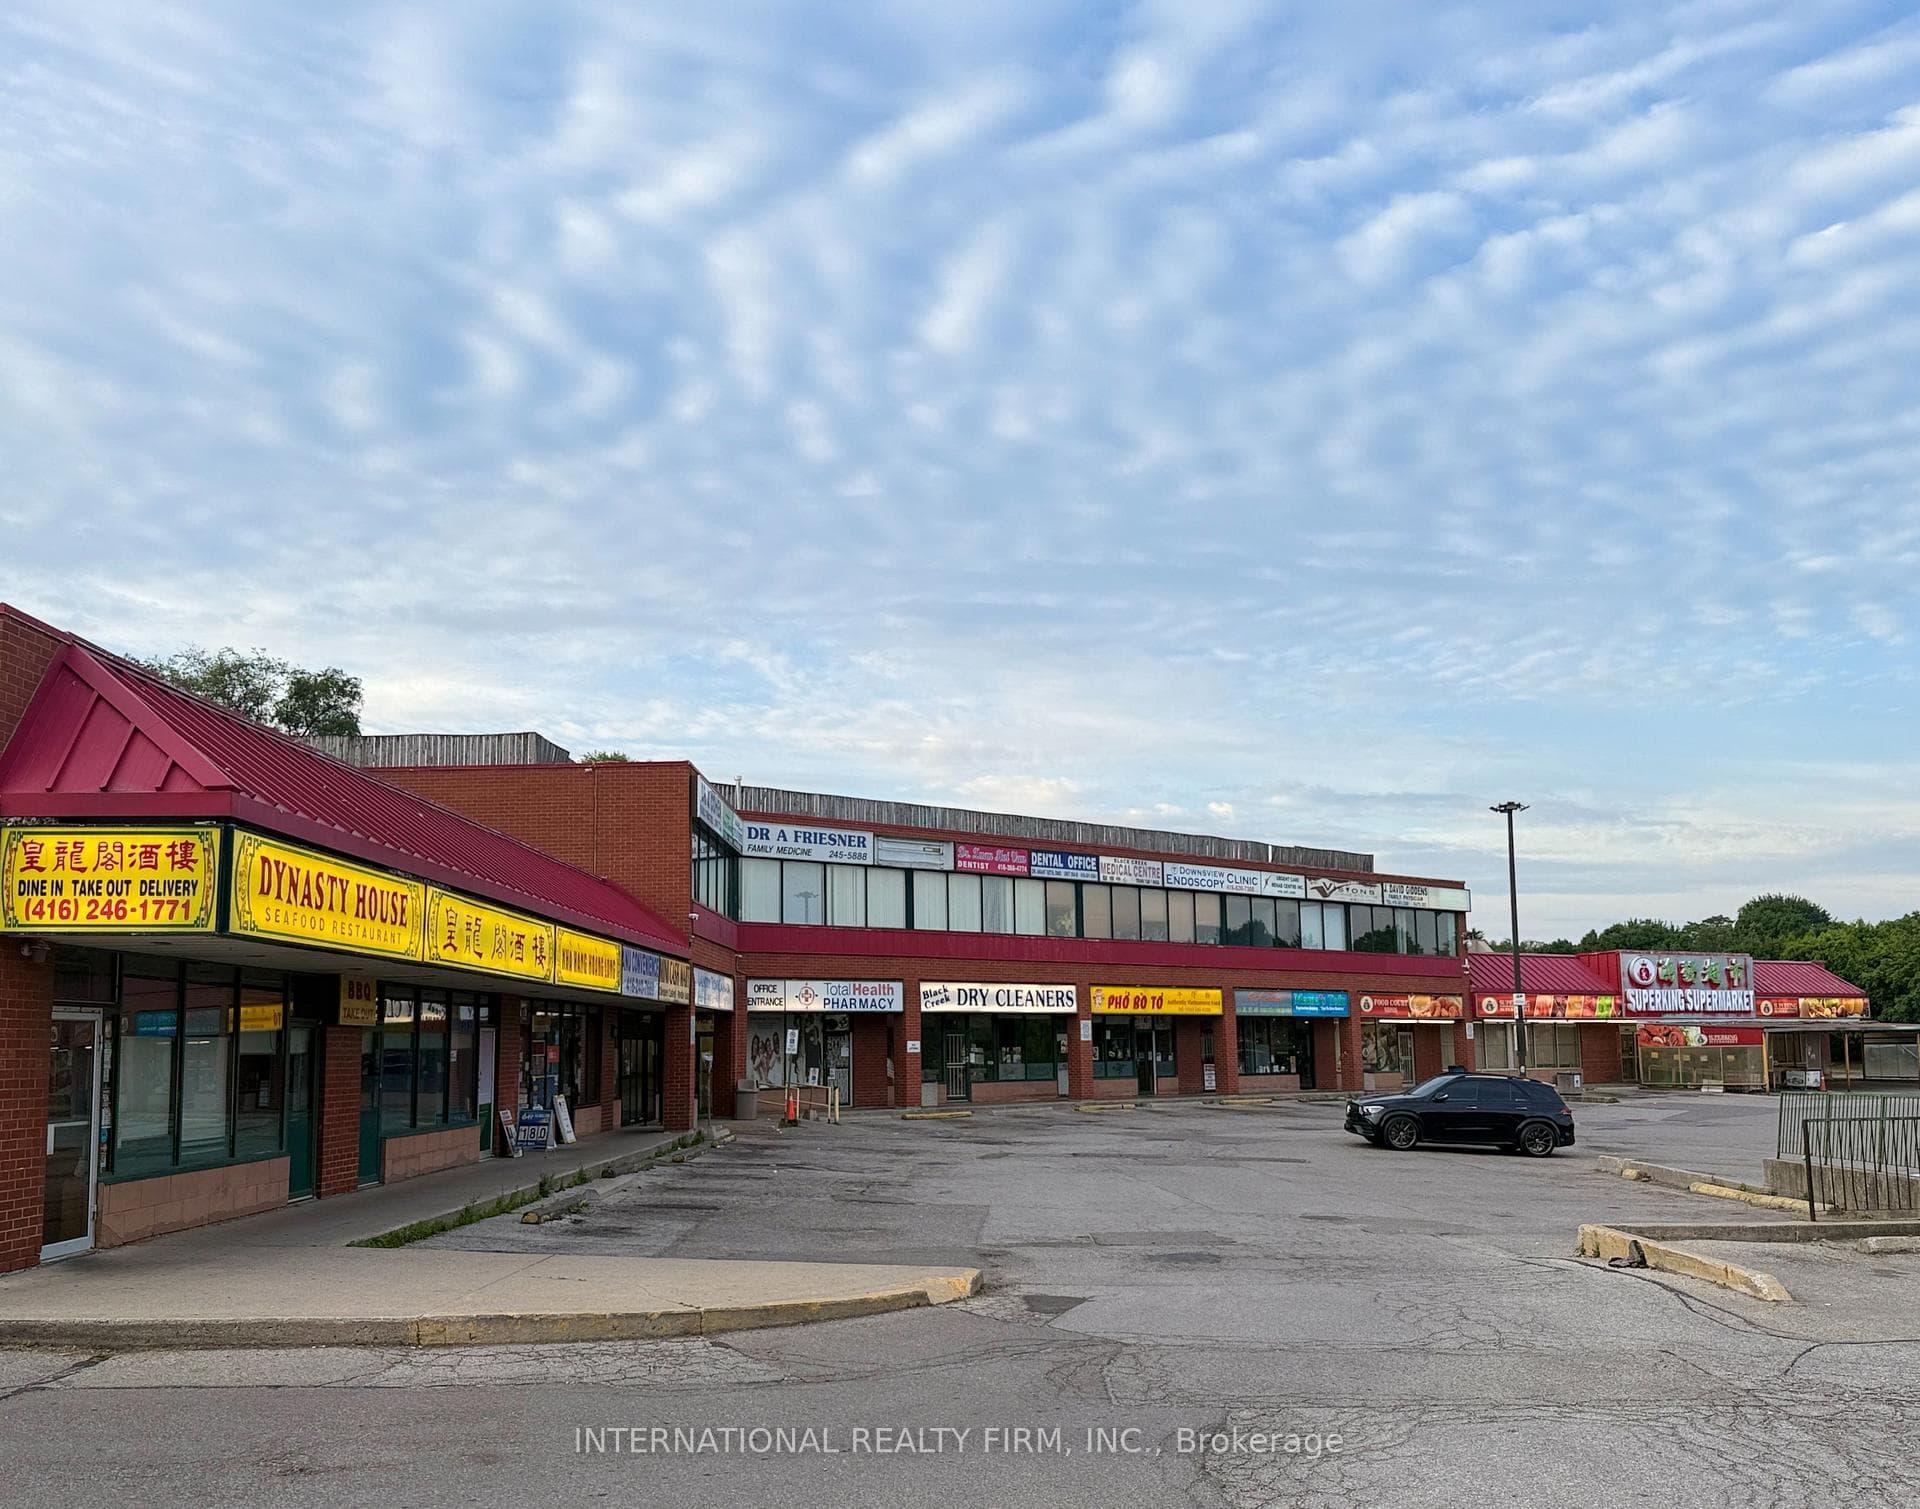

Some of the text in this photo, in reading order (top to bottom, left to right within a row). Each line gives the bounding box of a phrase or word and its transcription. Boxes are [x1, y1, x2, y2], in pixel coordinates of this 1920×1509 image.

[747, 827, 770, 841] DR
[777, 829, 788, 842] A
[793, 830, 867, 849] FRIESNER
[20, 840, 199, 873] 皇龍閣酒樓
[747, 844, 867, 861] FAMILY MEDICINE 245-5888
[1031, 852, 1064, 868] DENTAL
[1067, 855, 1097, 871] OFFICE
[958, 860, 989, 870] DENTIST
[1101, 863, 1132, 876] MEDICAL
[1133, 865, 1160, 879] CENTRE
[18, 880, 198, 897] DINE IN TAKE OUT DELIVERY
[259, 856, 408, 928] DYNASTY HOUSE
[25, 899, 190, 920] (416) 246-1771
[265, 907, 402, 944] SEAFOOD RESTAURANT
[348, 981, 371, 1001] BBQ
[754, 984, 777, 993] OFFICE
[922, 985, 1074, 1008] Black DRY CLEANERS
[747, 997, 894, 1009] ENTRANCE PHARMACY
[924, 994, 950, 1009] Creek
[1626, 990, 1753, 1012] SUPERKING SUPERMARKET
